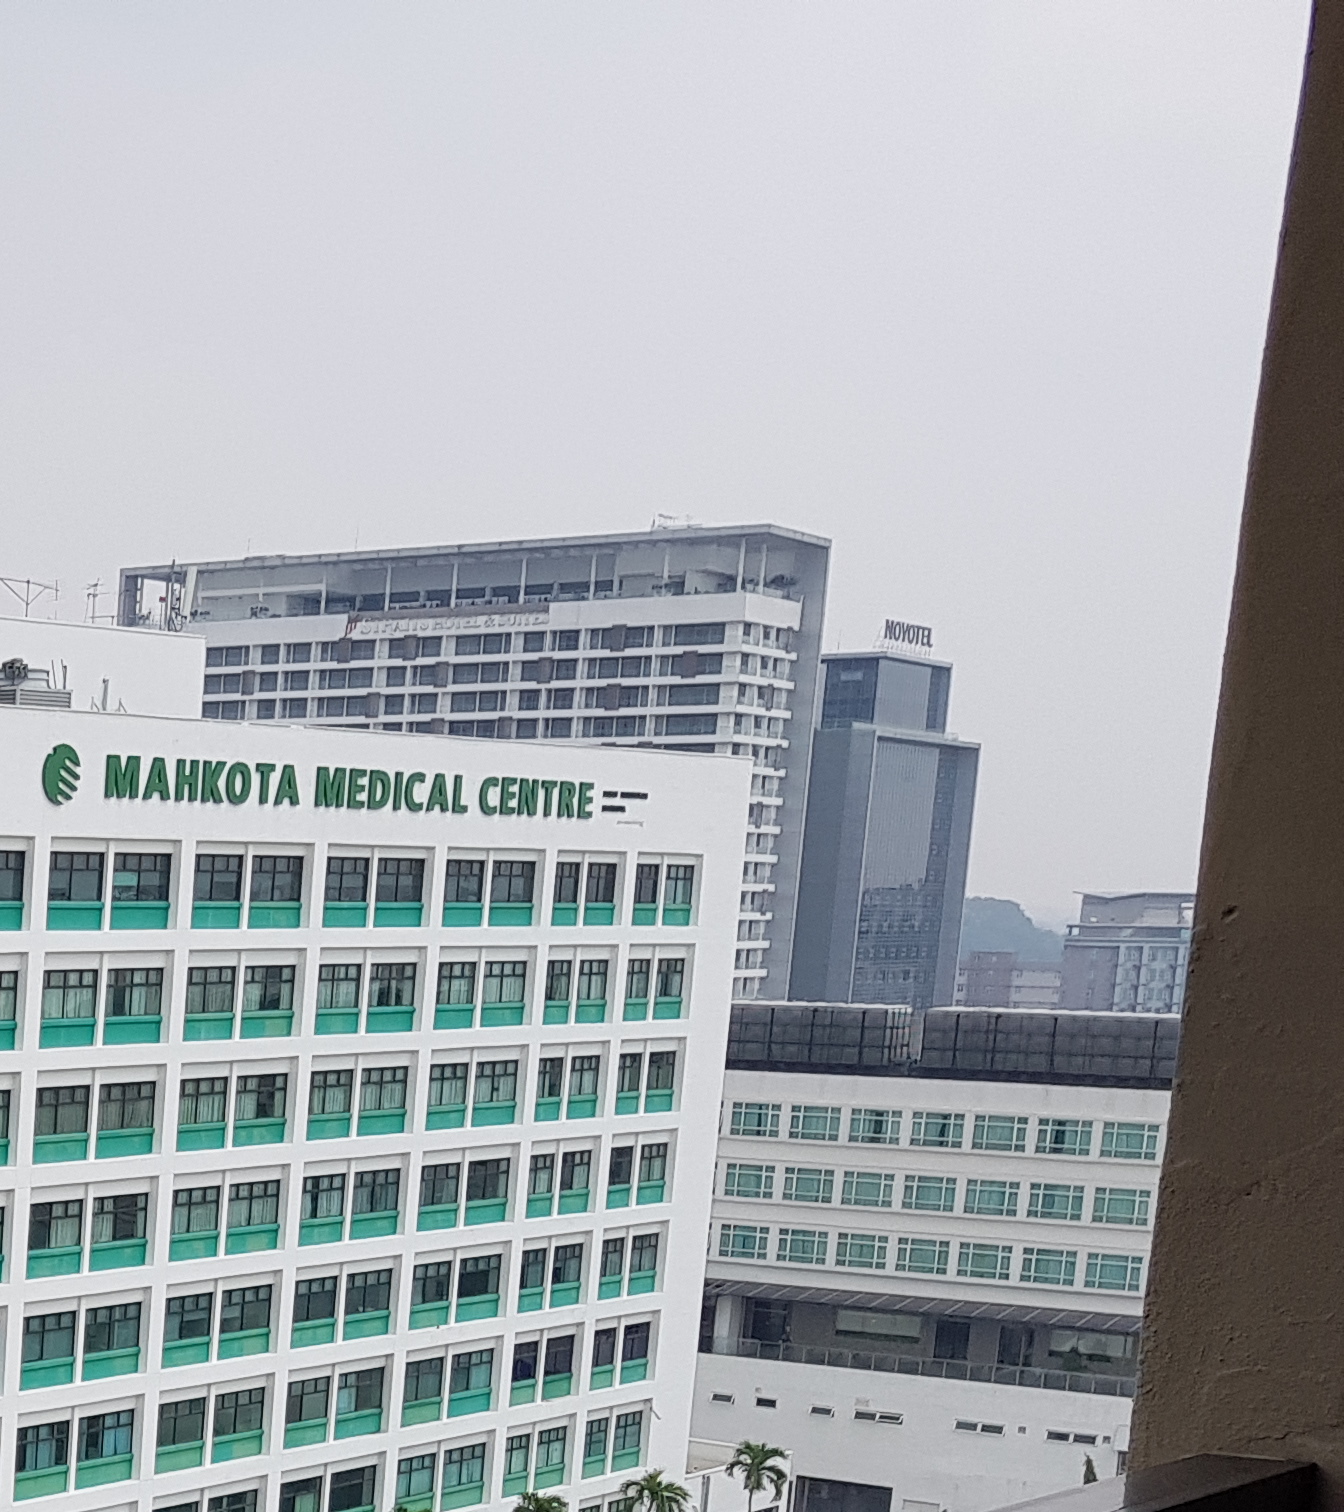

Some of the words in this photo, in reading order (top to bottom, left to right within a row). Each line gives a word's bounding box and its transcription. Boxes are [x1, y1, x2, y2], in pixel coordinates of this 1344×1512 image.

[884, 619, 933, 648] NOVOTEL
[104, 753, 300, 807] MAHKOTA
[314, 766, 468, 814] MEDICAL
[479, 776, 594, 820] CENTRE
